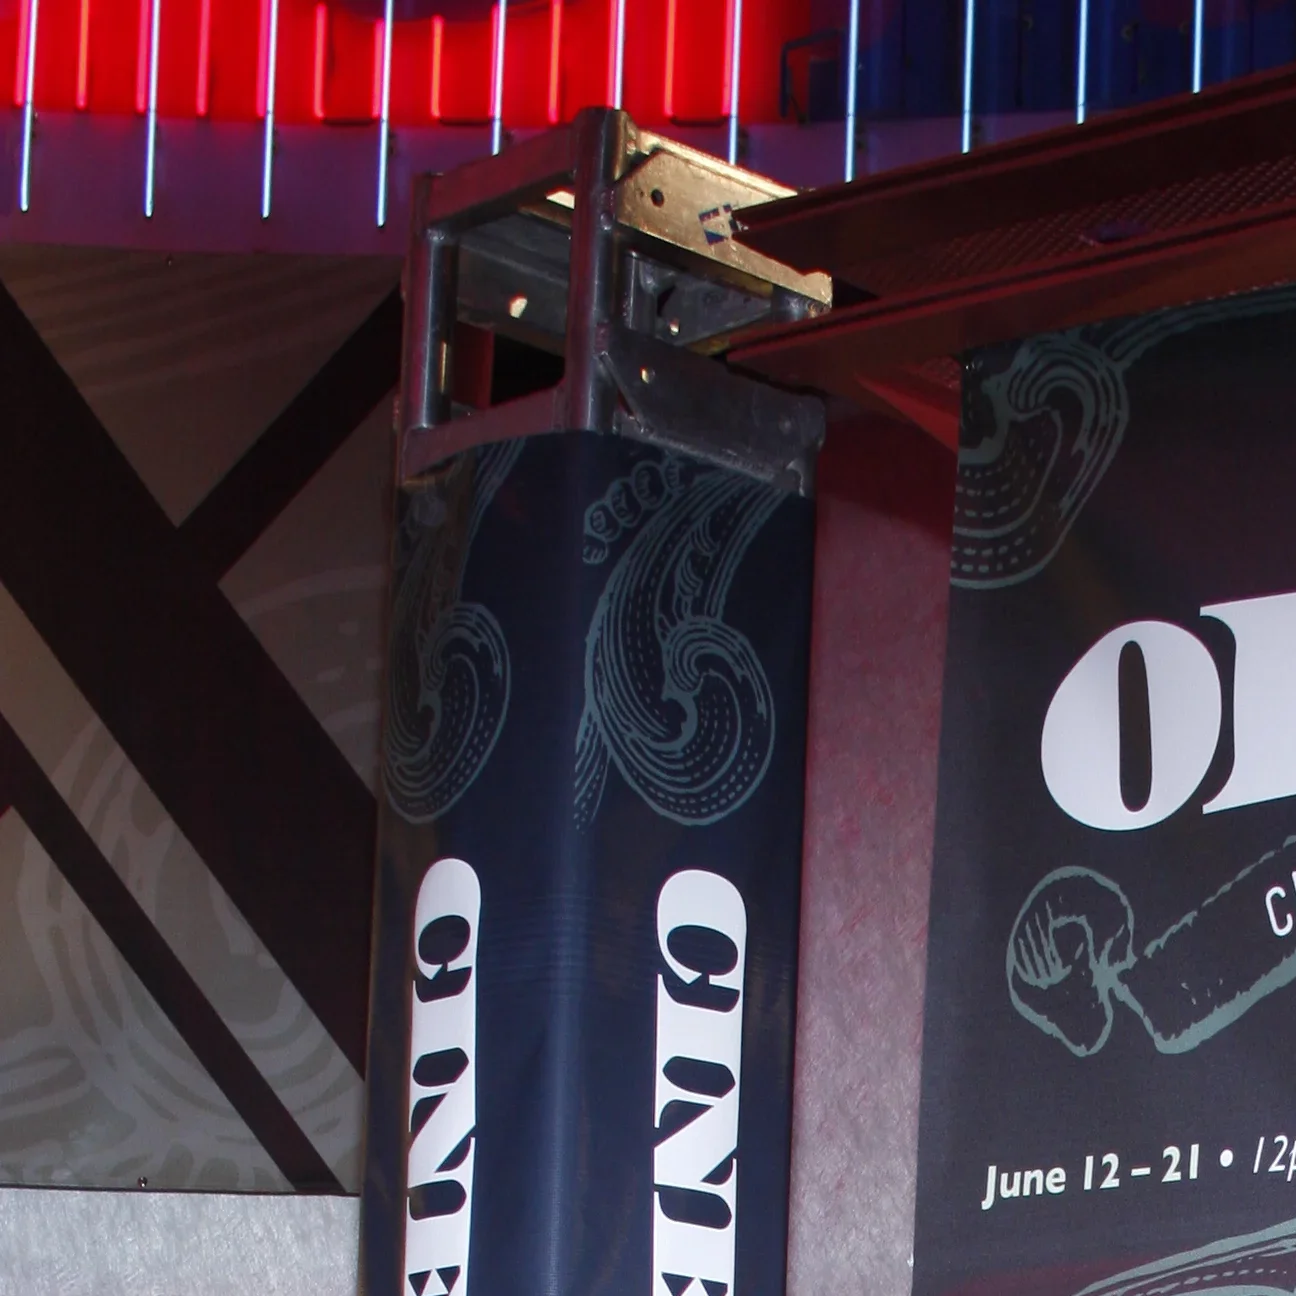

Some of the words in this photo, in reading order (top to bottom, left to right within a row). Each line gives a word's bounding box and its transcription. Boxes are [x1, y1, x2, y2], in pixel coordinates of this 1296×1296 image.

[982, 1164, 1066, 1210] June
[1084, 1153, 1120, 1190] 12
[1162, 1143, 1199, 1182] 21
